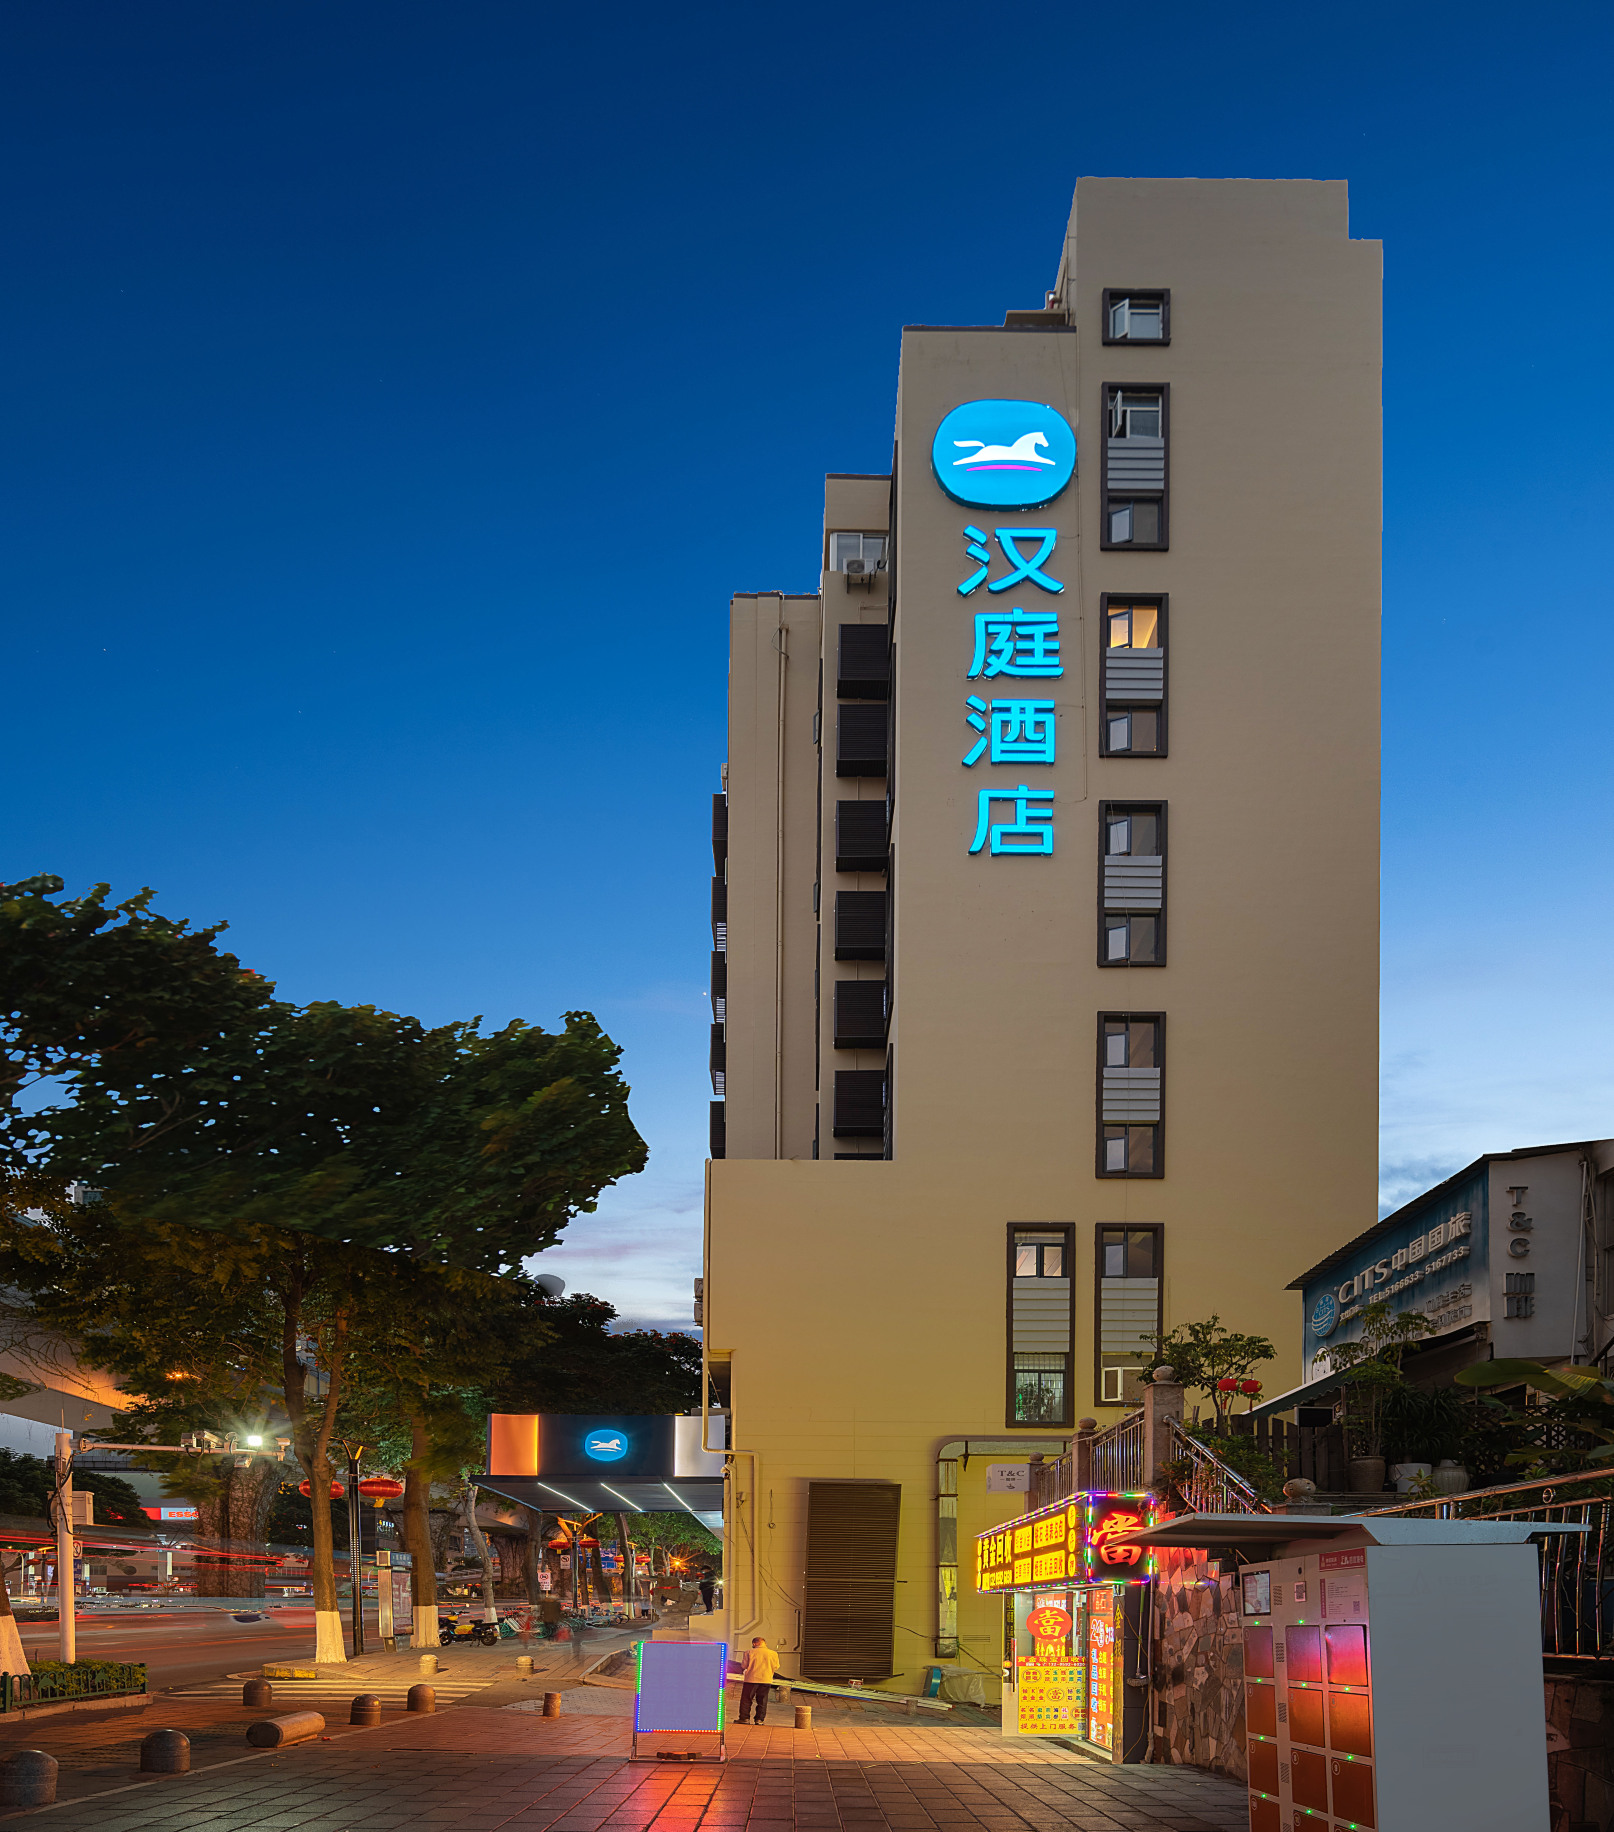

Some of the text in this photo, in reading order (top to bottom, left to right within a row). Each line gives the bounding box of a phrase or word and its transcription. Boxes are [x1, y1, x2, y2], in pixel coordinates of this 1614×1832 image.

[956, 525, 1064, 857] 汉庭酒店
[1338, 1211, 1472, 1304] CITS 中国国旅
[1506, 1186, 1534, 1258] T&C
[1425, 1245, 1470, 1275] 5167733
[983, 1529, 1012, 1569] 黄金回收
